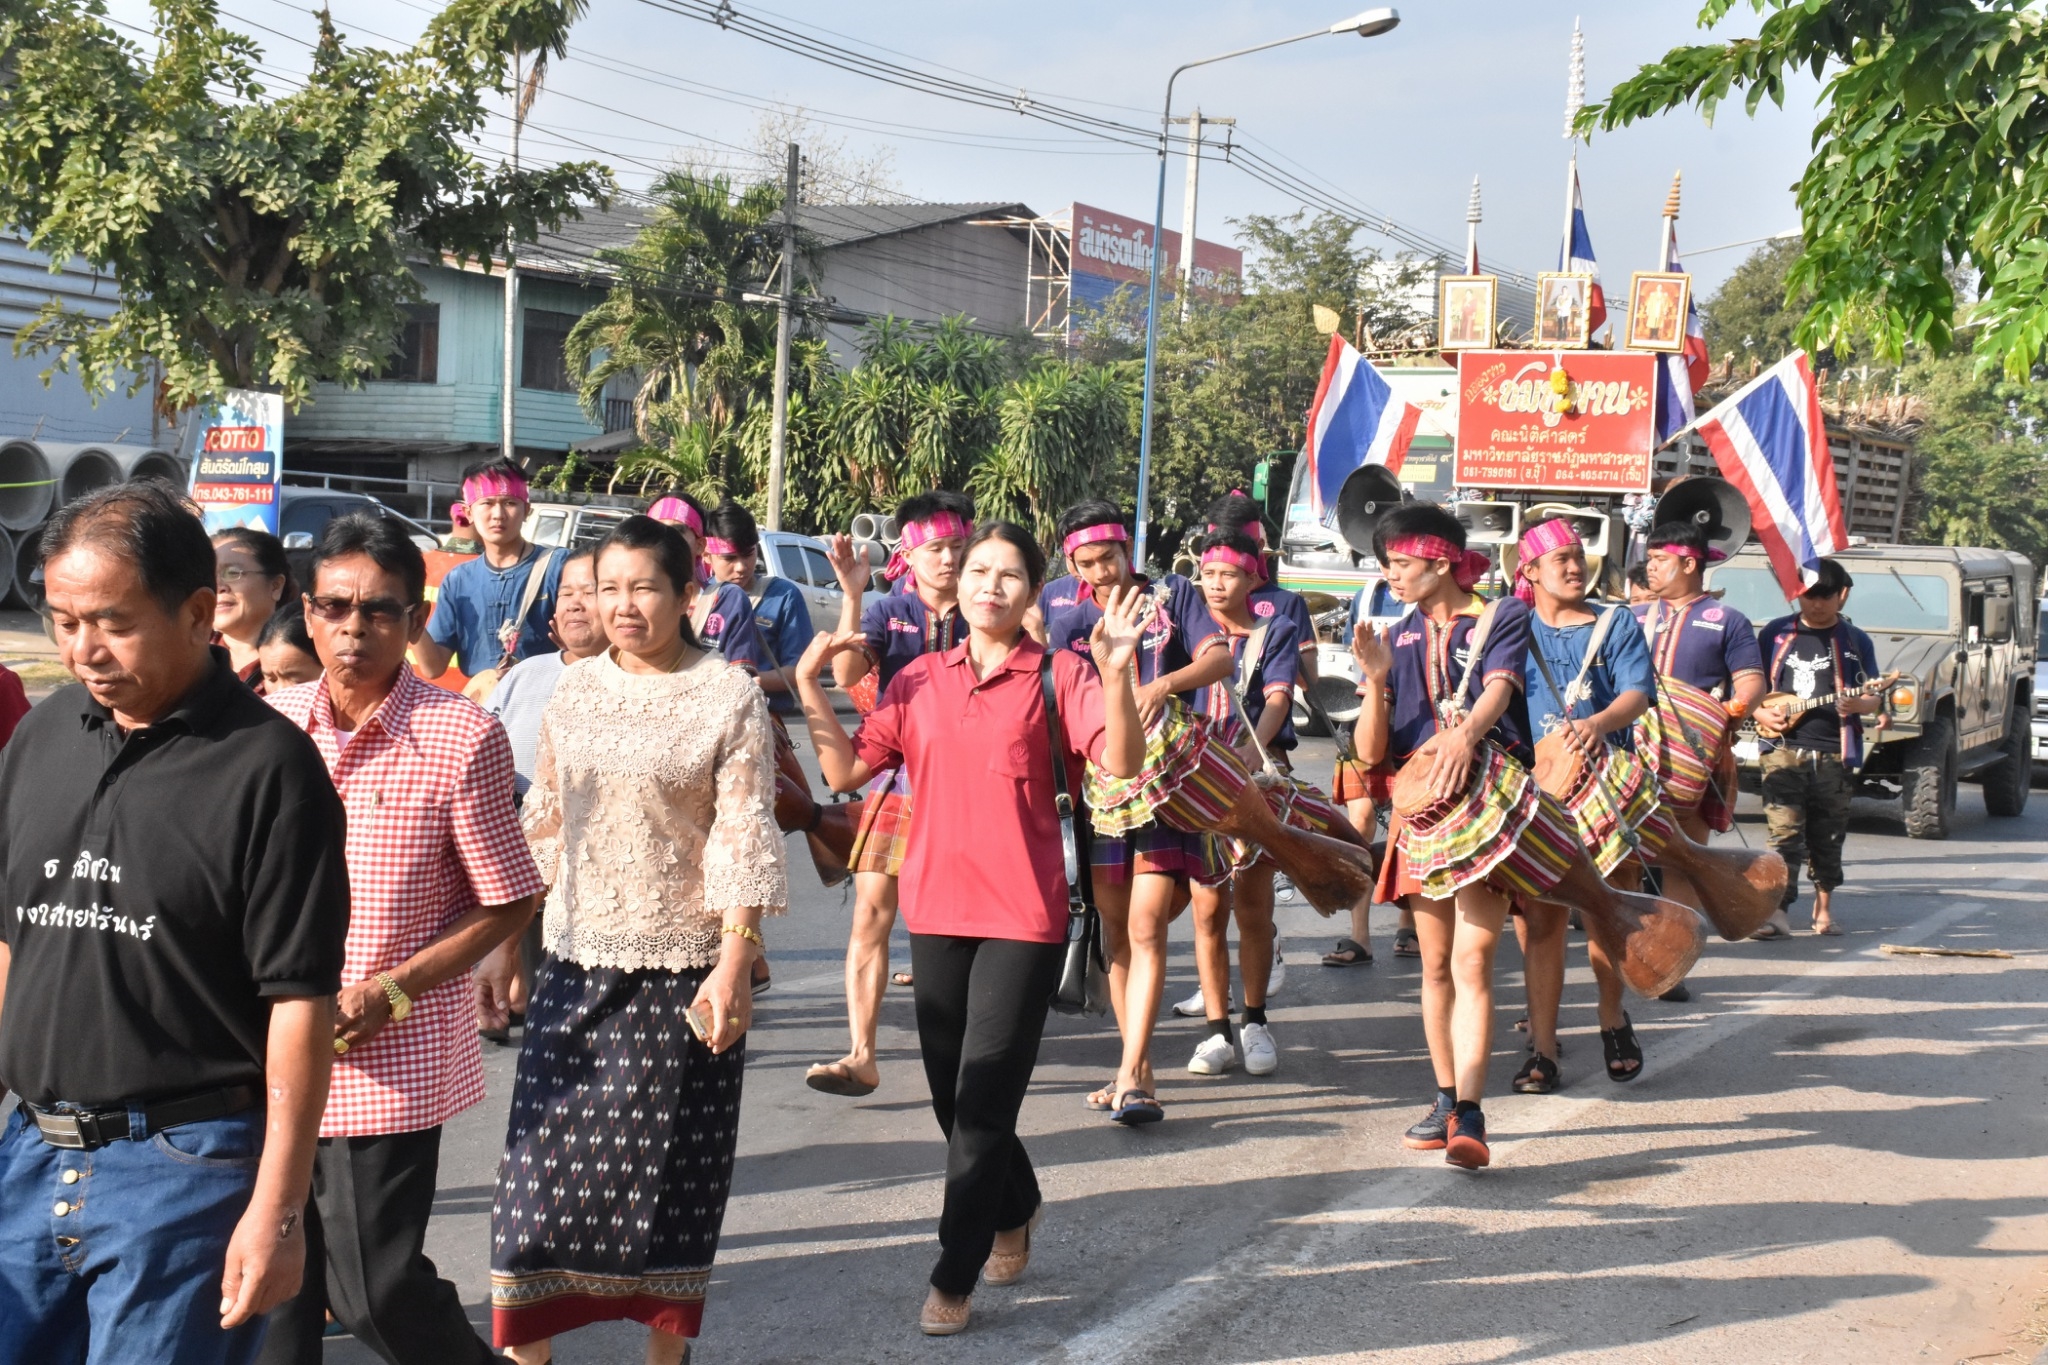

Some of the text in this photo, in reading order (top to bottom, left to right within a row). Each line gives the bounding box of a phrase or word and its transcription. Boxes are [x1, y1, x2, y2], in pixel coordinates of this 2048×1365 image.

[210, 430, 260, 449] COTTO
[1490, 424, 1589, 444] คณะนิติศาสตร์
